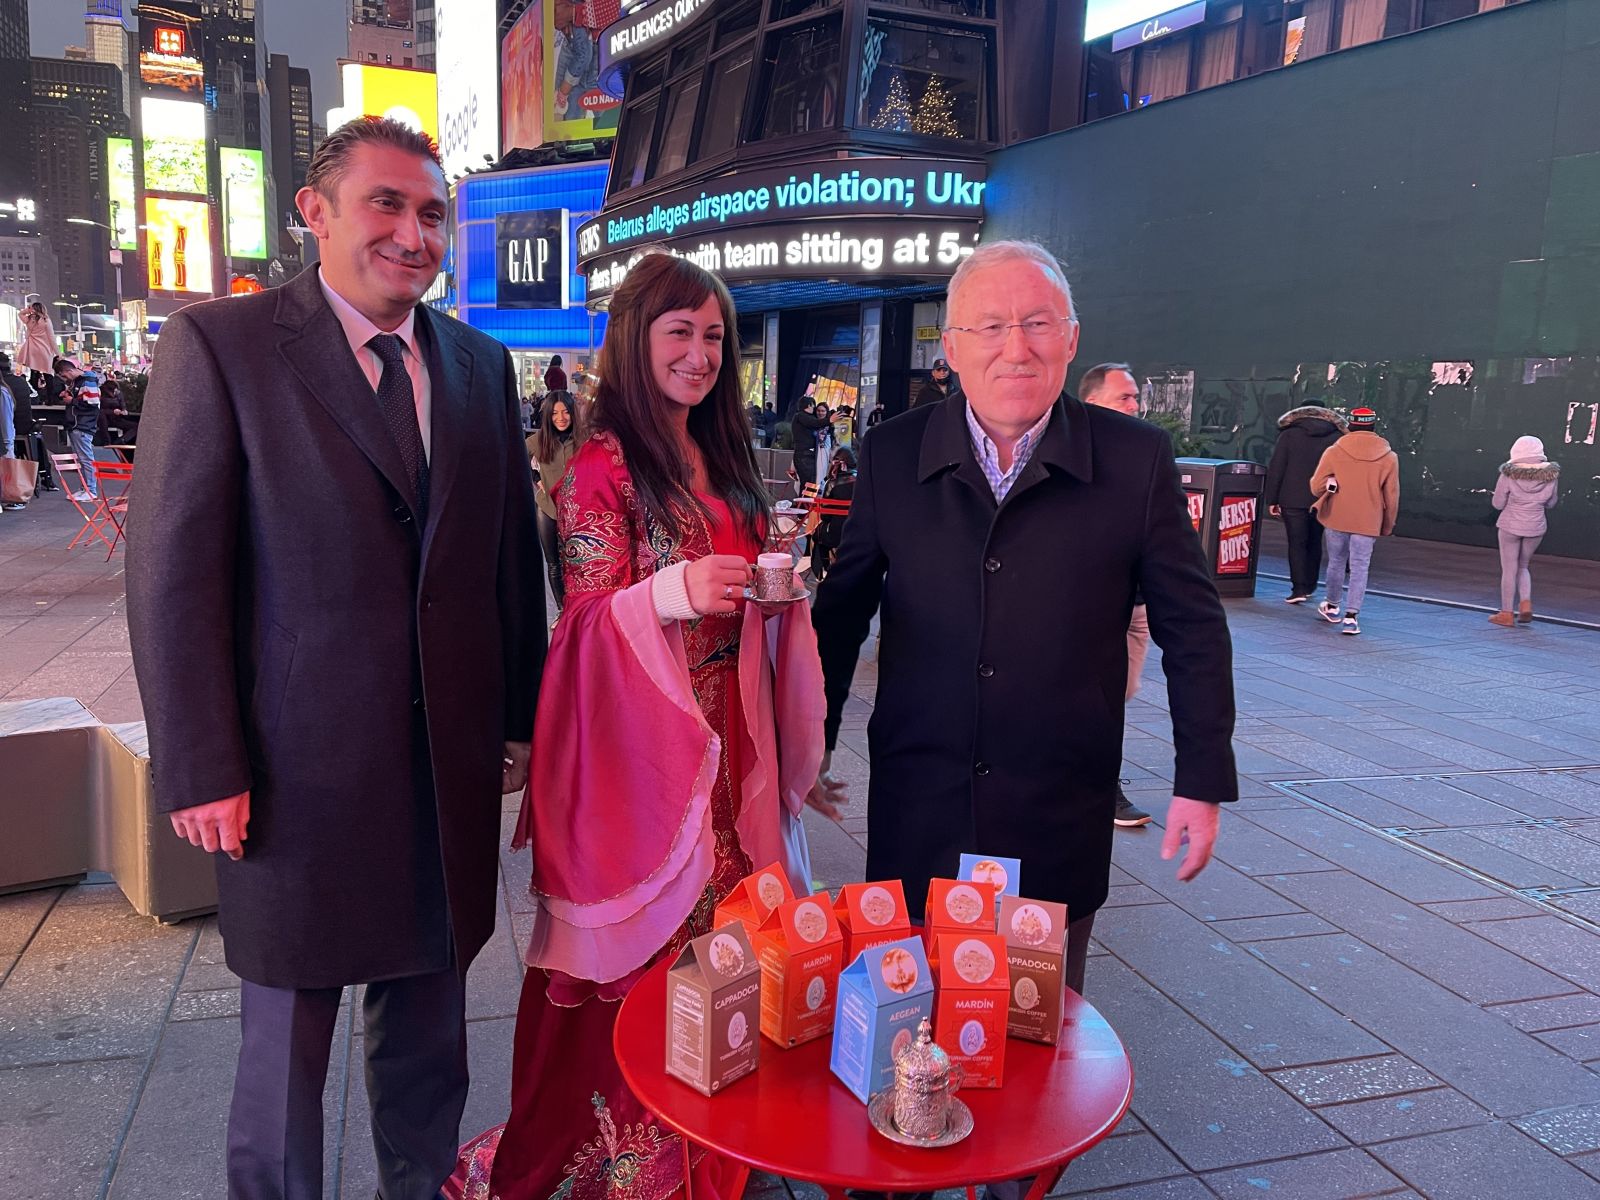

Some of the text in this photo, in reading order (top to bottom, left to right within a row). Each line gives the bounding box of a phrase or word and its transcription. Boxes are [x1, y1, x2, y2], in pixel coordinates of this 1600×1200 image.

[610, 6, 674, 55] INFLUENCES
[1141, 19, 1172, 41] Calm
[583, 95, 619, 106] OLD NAV
[444, 85, 478, 158] Google
[579, 170, 986, 257] NEWS Belarus alleges airspace violation; Ukr
[508, 237, 548, 283] GAP
[685, 231, 979, 271] with team sitting at 5-
[1218, 498, 1257, 530] JERSEY
[1220, 534, 1250, 564] BOYS
[1007, 956, 1057, 972] APPADOCIA
[714, 983, 759, 1010] CAPPADOCIA
[889, 1005, 921, 1023] AEGEAN
[1027, 1010, 1048, 1018] COFFEE
